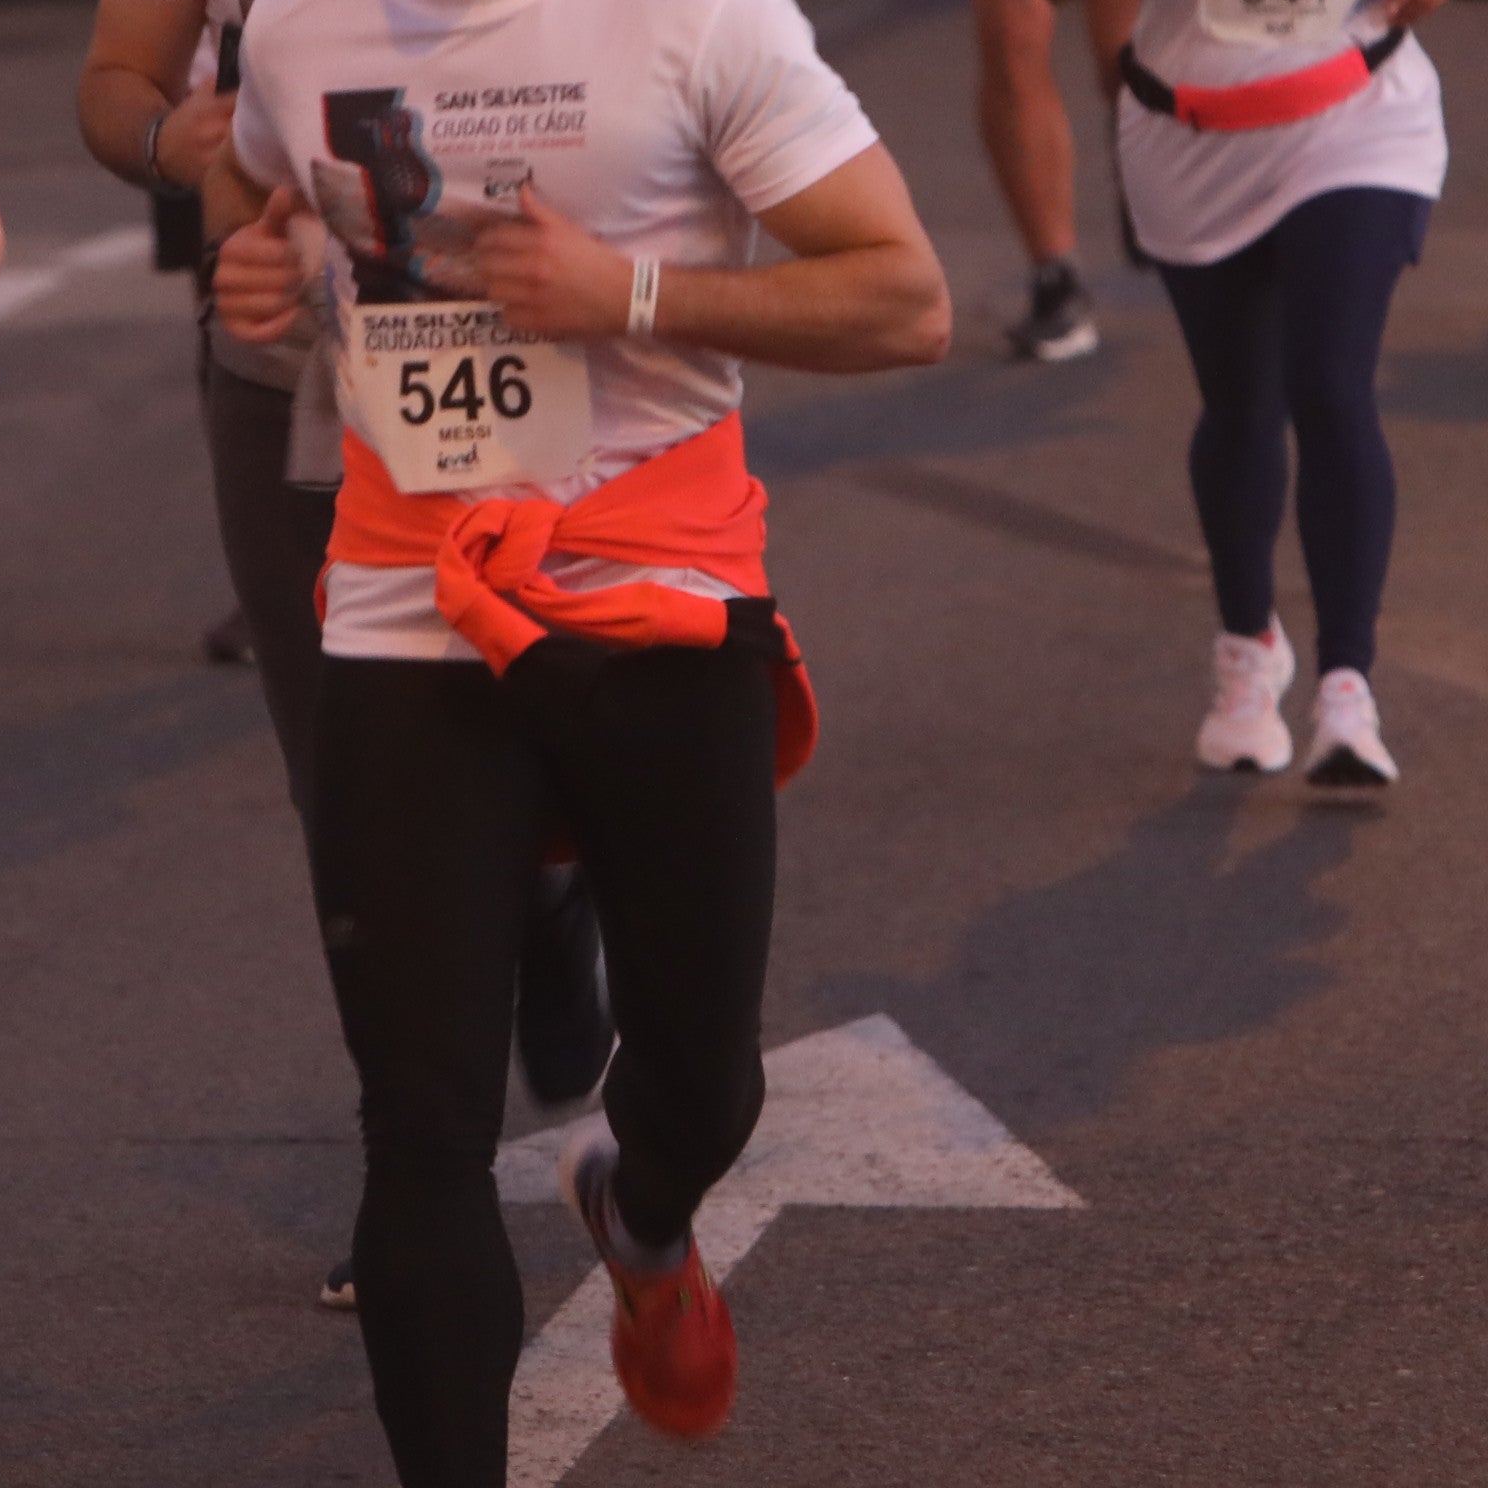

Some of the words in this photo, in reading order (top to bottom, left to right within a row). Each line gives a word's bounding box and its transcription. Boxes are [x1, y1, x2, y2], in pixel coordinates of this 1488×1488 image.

[435, 91, 478, 111] SAN
[481, 83, 587, 108] SILVESTRE
[431, 116, 501, 140] CIUDAD
[506, 113, 528, 135] DE
[364, 315, 407, 331] SAN
[366, 329, 443, 352] CIUDAD
[451, 326, 484, 348] DE
[399, 354, 533, 426] 546
[439, 425, 492, 442] MESSI
